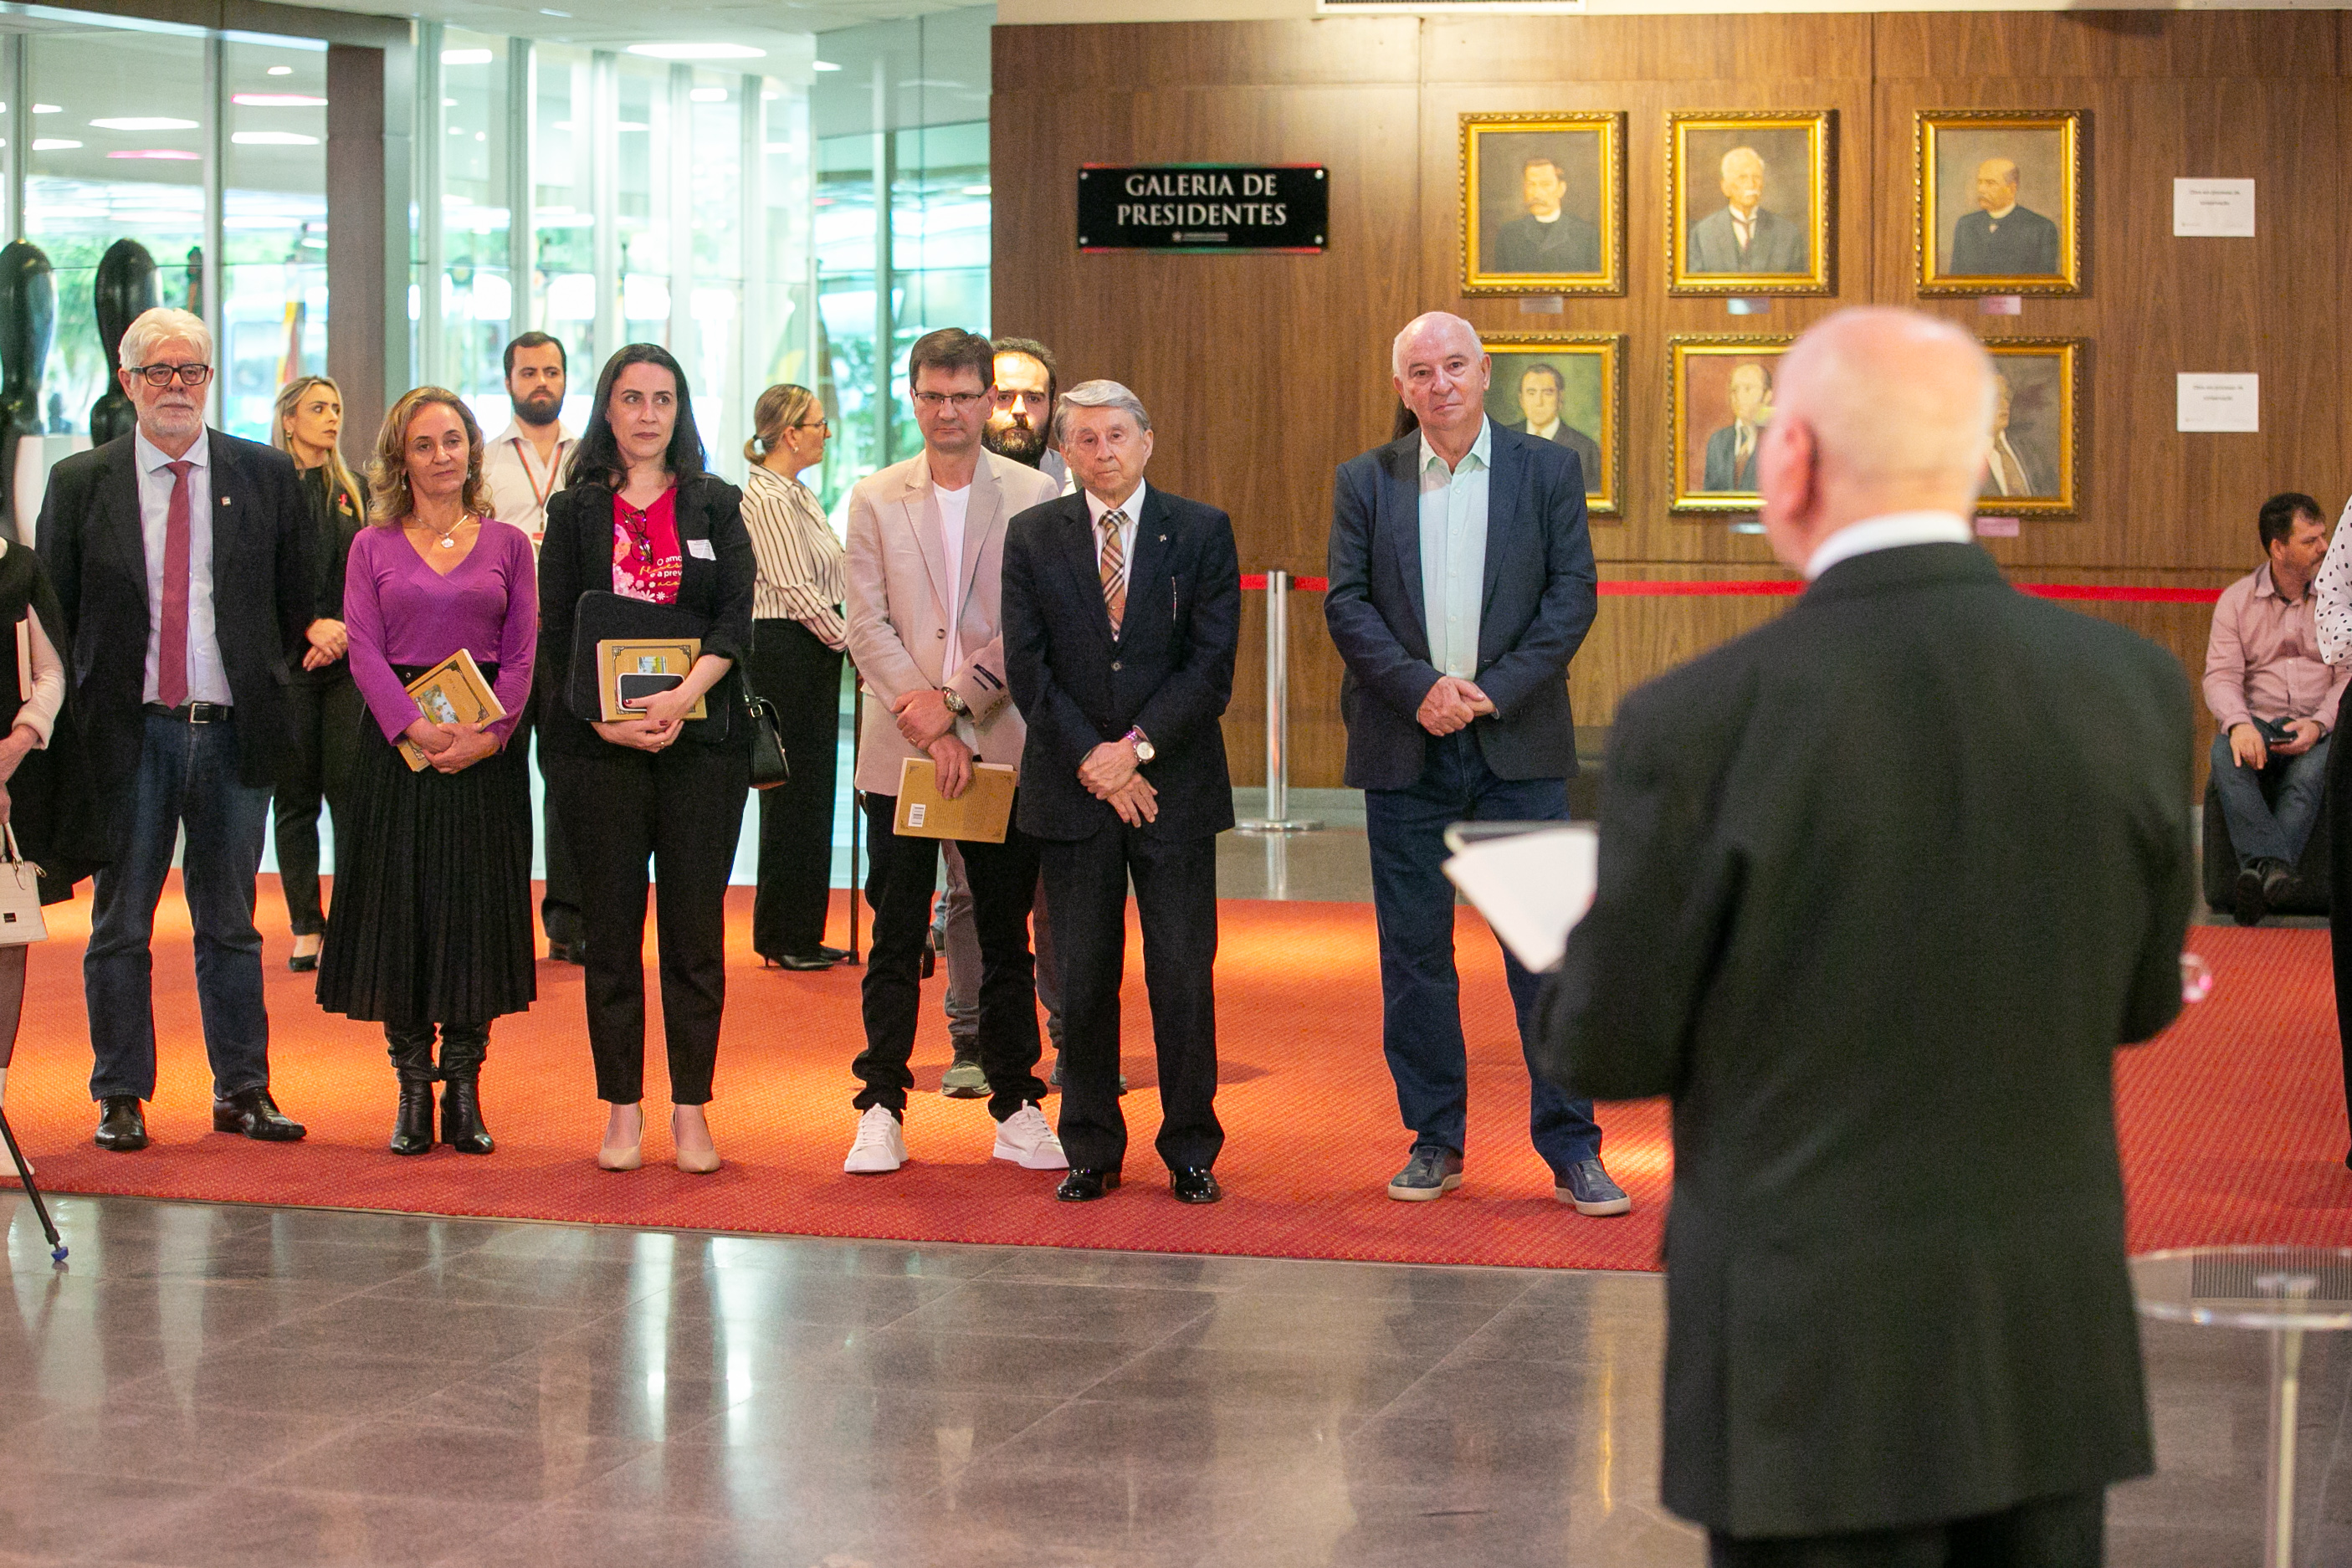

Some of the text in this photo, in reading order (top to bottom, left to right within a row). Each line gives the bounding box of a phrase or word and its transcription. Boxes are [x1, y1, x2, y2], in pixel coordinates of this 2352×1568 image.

[1125, 173, 1278, 197] GALERIA DE
[1117, 203, 1287, 226] PRESIDENTES
[657, 558, 664, 566] O
